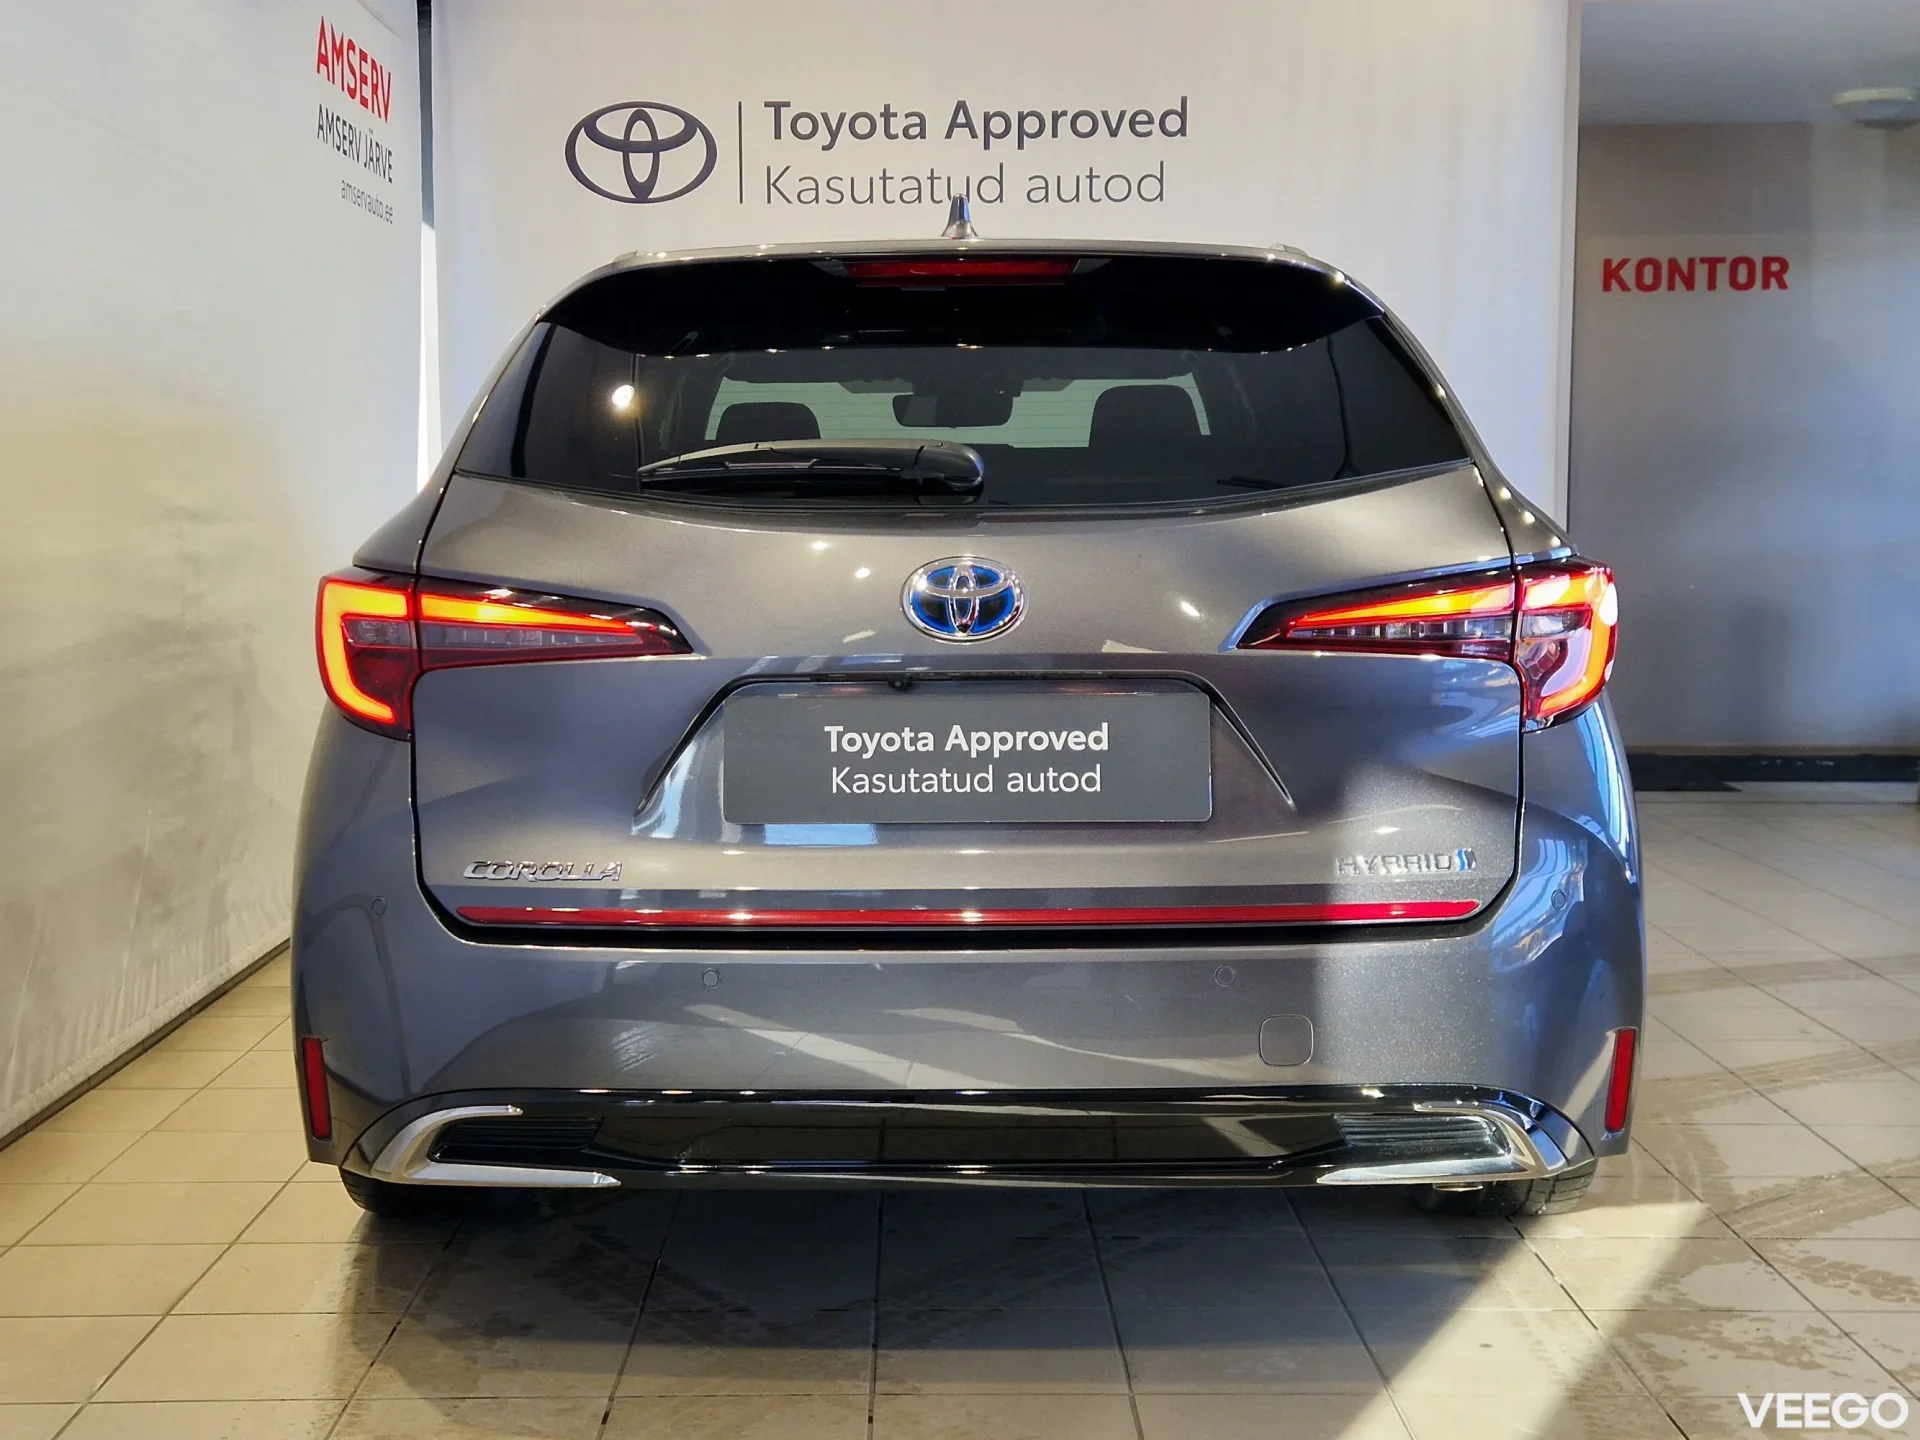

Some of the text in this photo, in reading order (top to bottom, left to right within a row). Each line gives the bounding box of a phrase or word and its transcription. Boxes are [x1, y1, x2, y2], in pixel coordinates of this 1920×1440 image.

[316, 15, 392, 124] AMSERV
[317, 103, 393, 184] AMSERV JÄRVE
[763, 95, 1189, 151] Toyota Approved
[340, 179, 393, 224] amservauto.ee
[765, 161, 1165, 205] Kasutatud autod
[1601, 255, 1790, 293] KONTOR
[824, 721, 1109, 759] Toyota Approved
[831, 763, 1102, 795] Kasutatud autod
[463, 860, 623, 882] COROLLA
[1335, 852, 1453, 876] HYBRID
